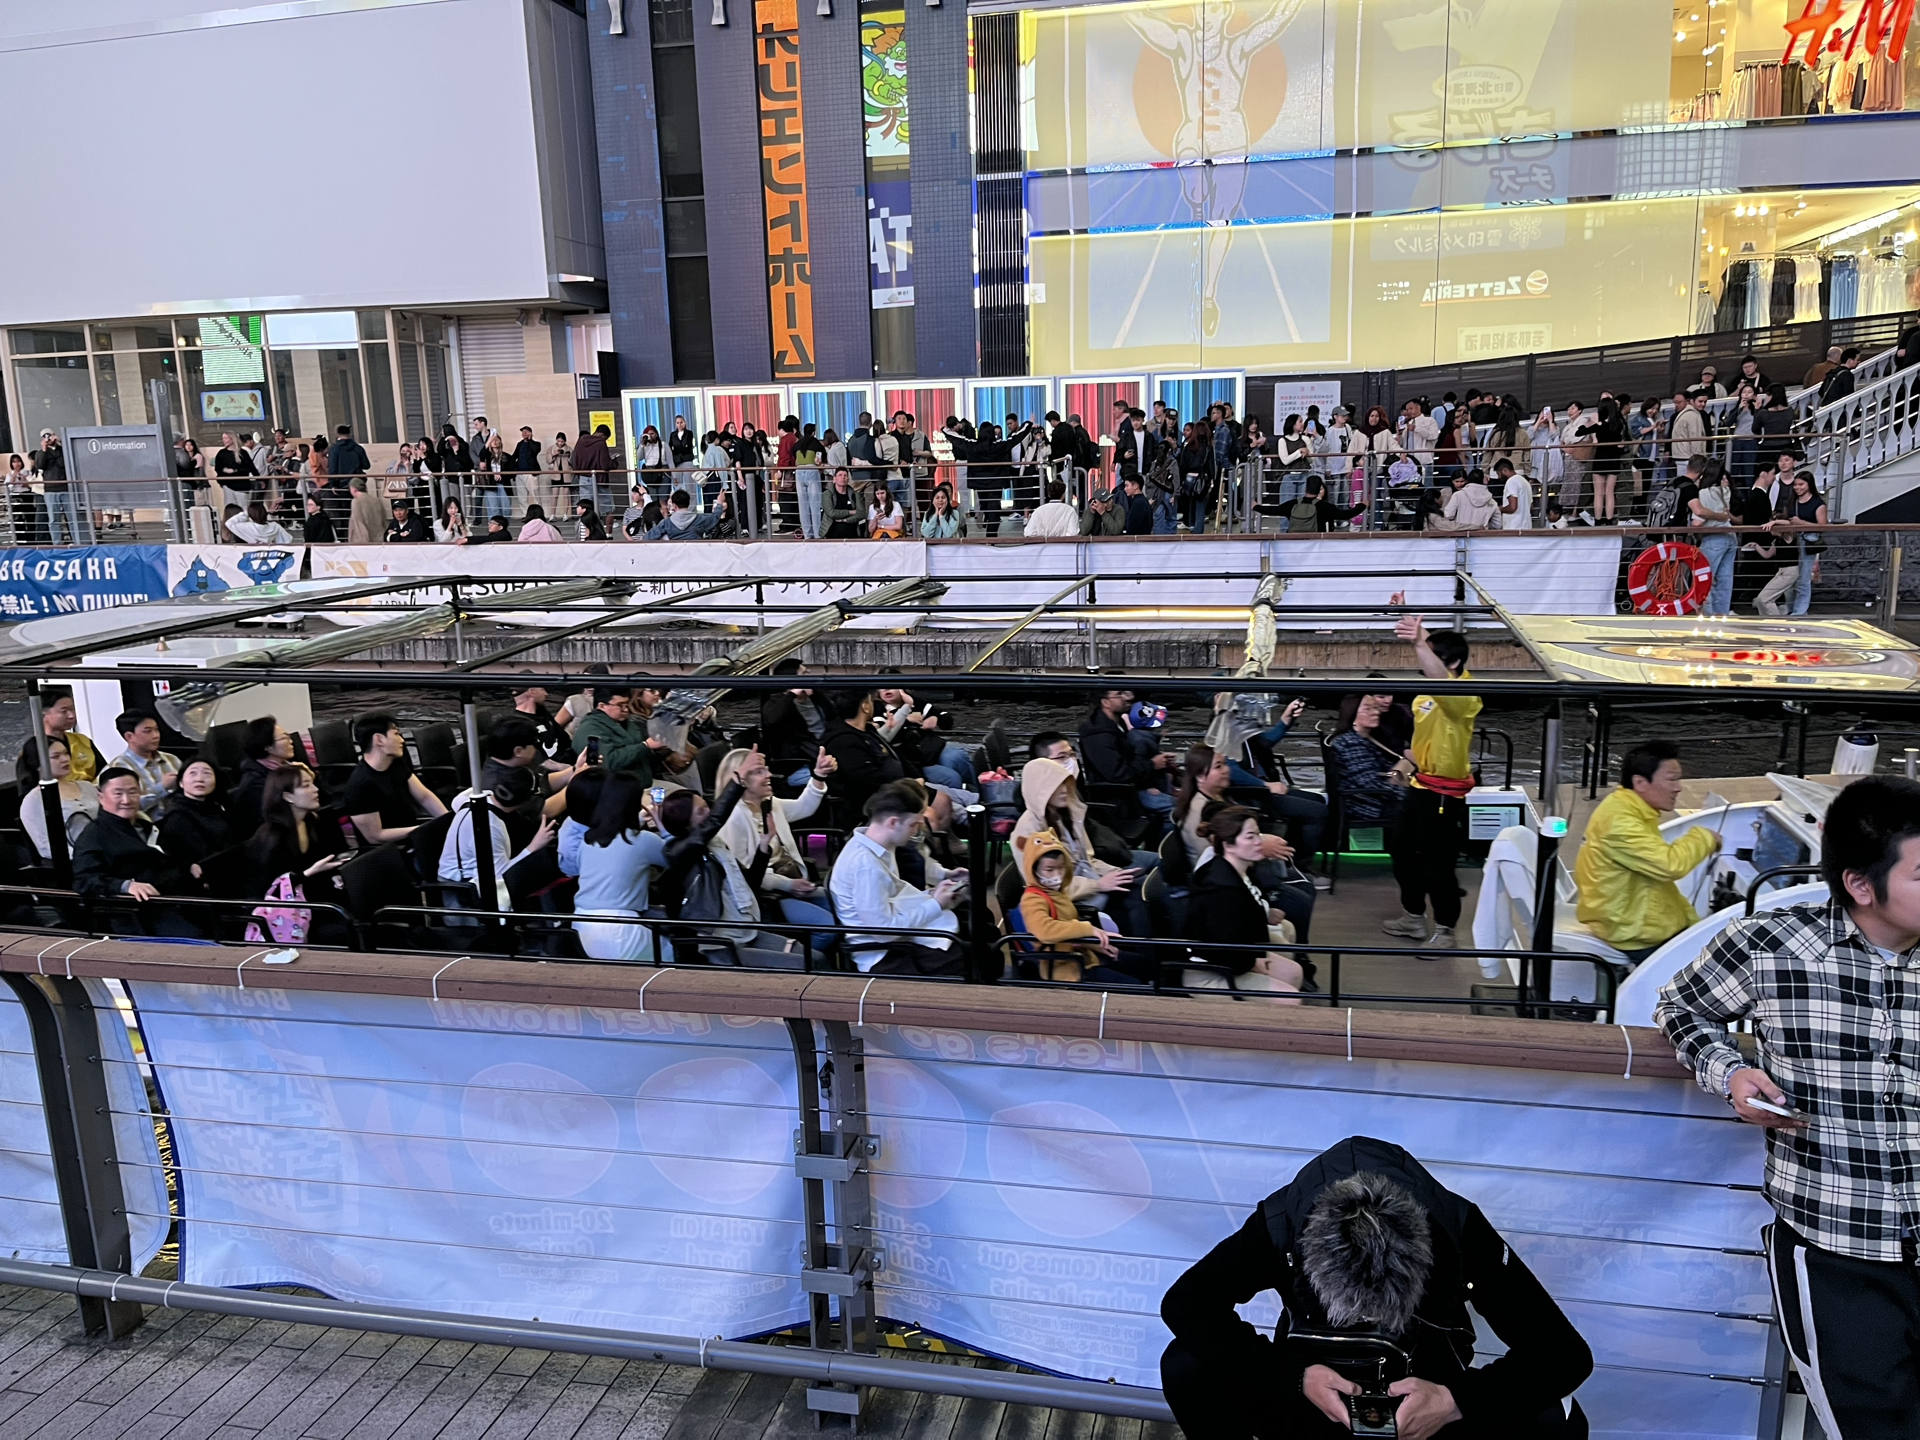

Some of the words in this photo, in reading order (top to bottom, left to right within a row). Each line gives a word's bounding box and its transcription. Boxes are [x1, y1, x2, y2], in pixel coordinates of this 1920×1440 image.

[1781, 0, 1916, 67] H&M
[102, 441, 146, 450] information
[34, 557, 118, 581] OSAKA
